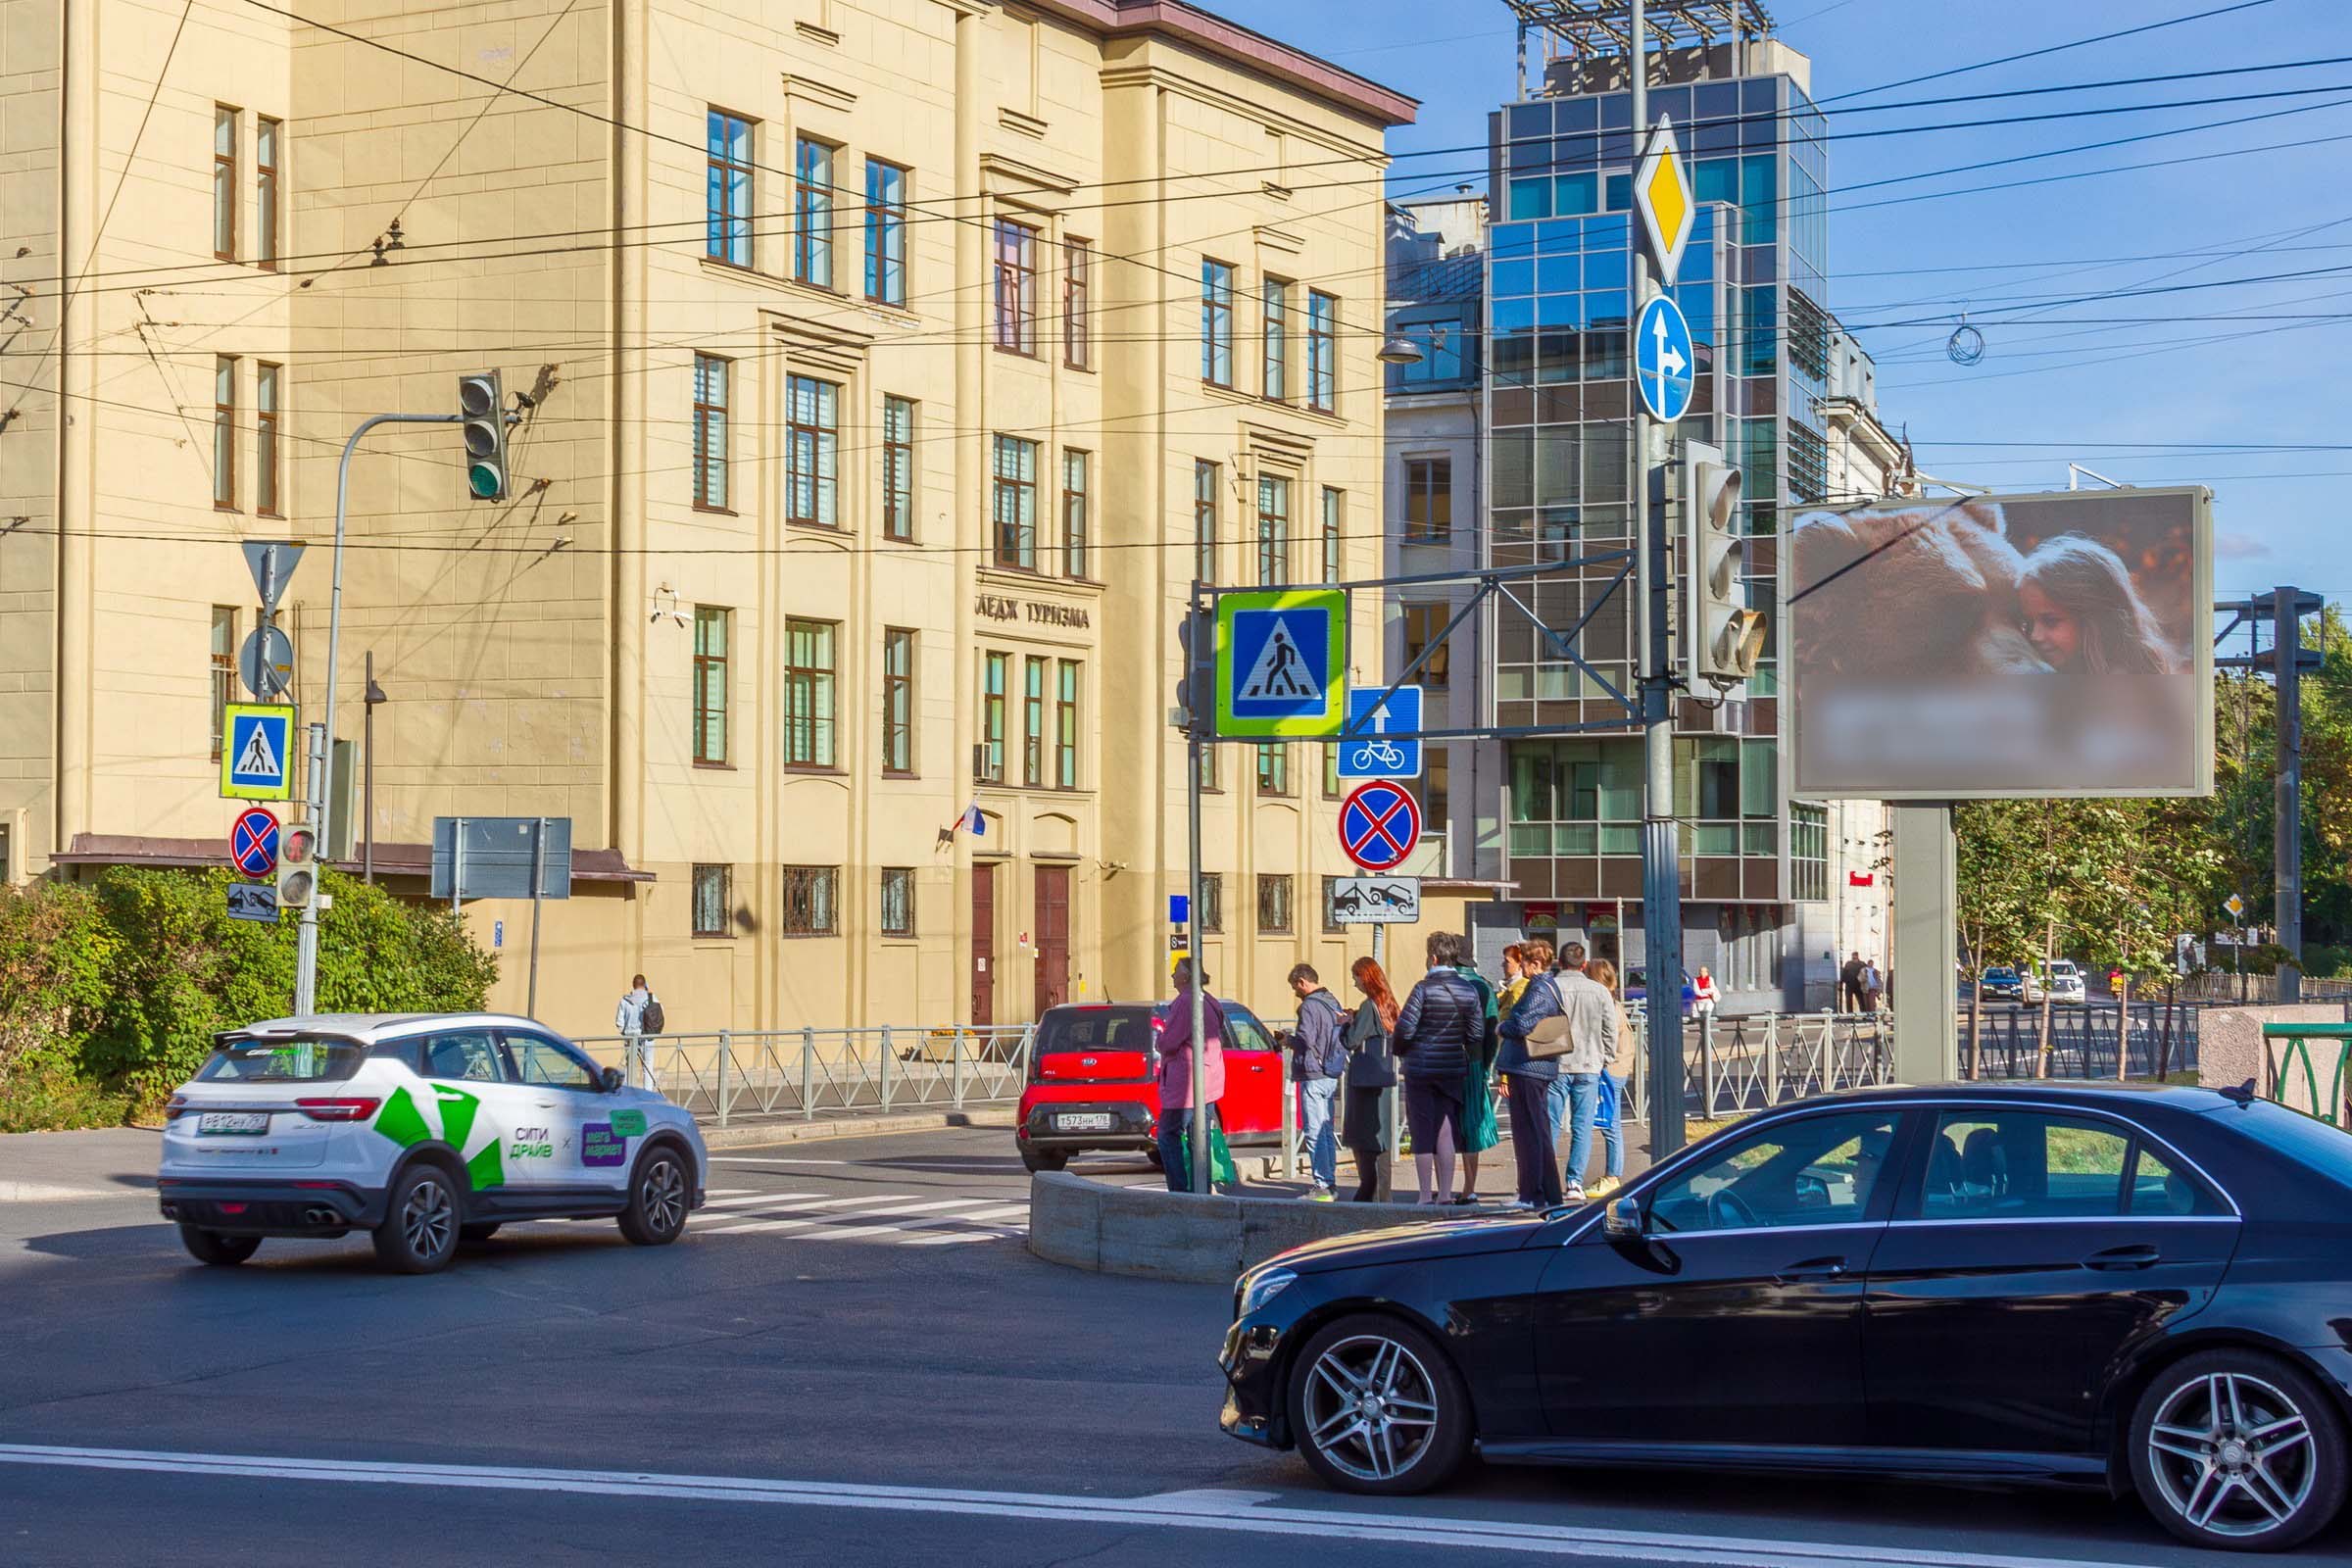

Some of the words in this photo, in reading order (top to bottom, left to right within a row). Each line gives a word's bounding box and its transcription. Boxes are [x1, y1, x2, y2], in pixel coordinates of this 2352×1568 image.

[974, 595, 1018, 621] ЛЕДЖ
[1026, 603, 1090, 629] ТУРИЗМА
[515, 1127, 549, 1141] СИТИ
[509, 1142, 554, 1159] ДРАЙВ
